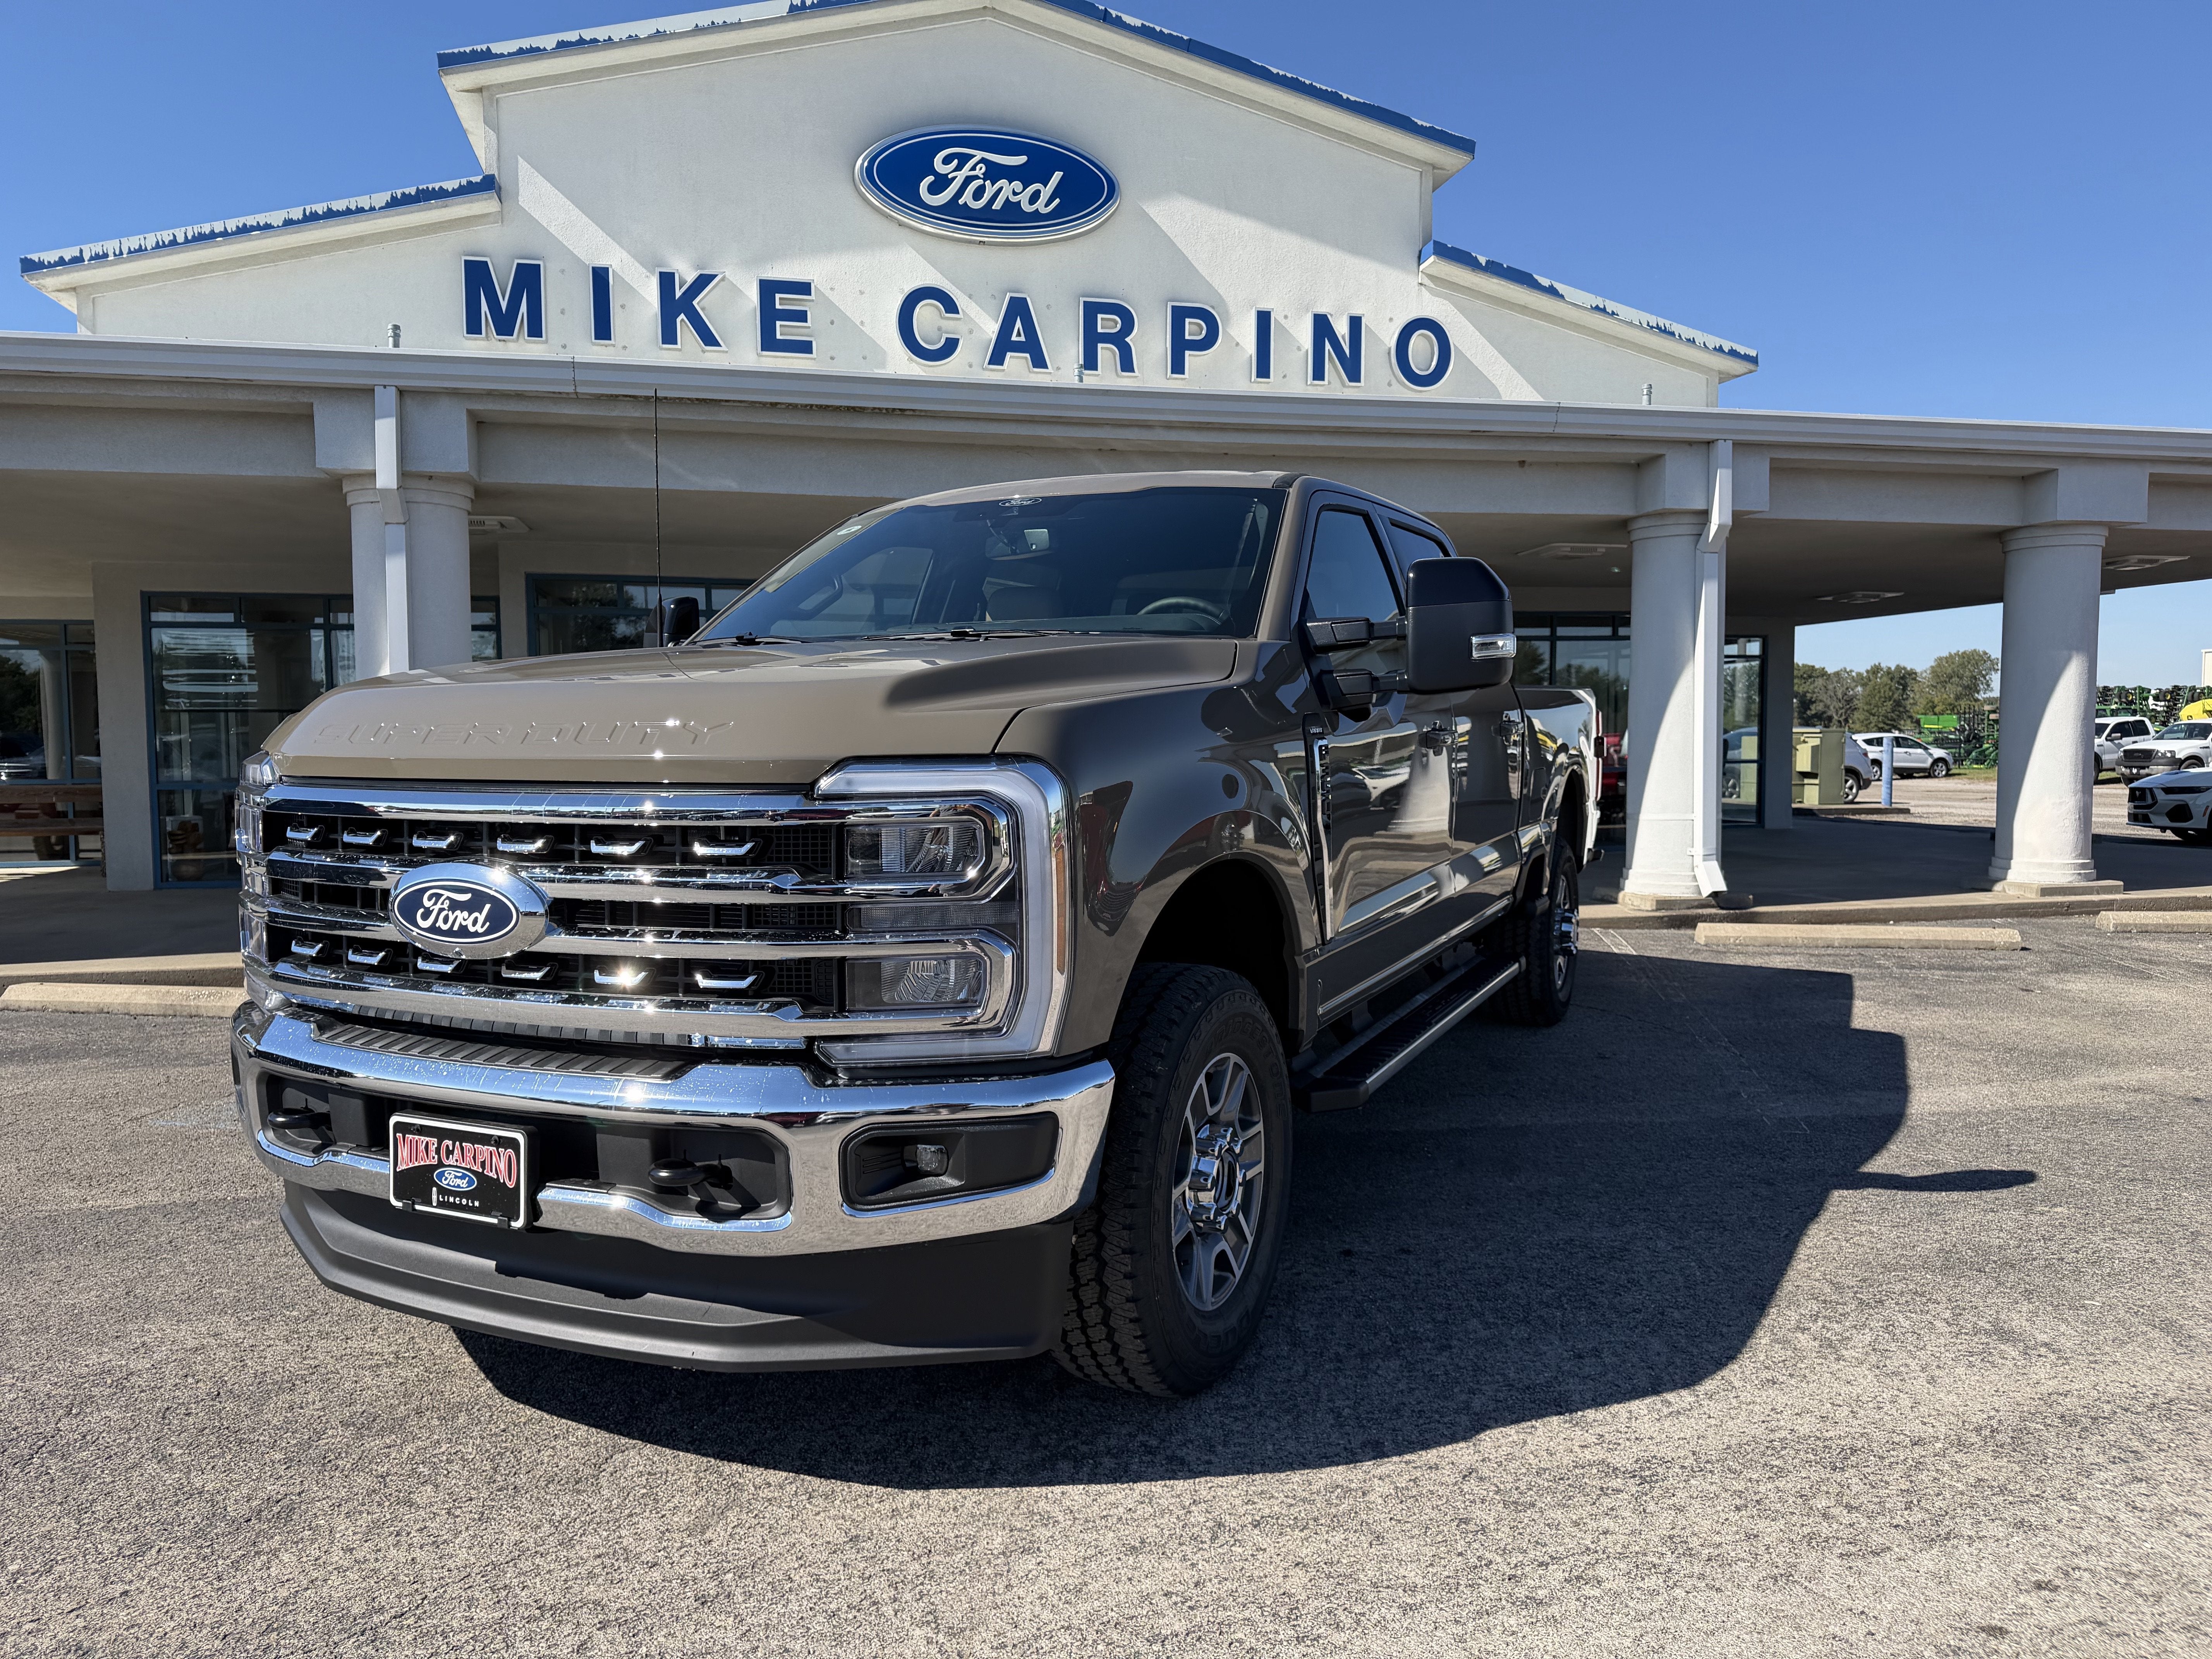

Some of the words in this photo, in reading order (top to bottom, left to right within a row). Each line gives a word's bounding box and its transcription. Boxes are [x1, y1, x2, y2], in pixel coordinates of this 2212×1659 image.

[919, 147, 1064, 214] Ford
[461, 255, 816, 359] MIKE
[895, 283, 1455, 392] CARPINO
[313, 722, 512, 745] SUPER
[520, 721, 734, 745] DUTY
[416, 888, 491, 933] Ford
[396, 1133, 438, 1171] MIKE
[441, 1140, 517, 1188] CARPINO
[442, 1170, 468, 1188] Ford
[440, 1194, 479, 1207] LINCOLN
